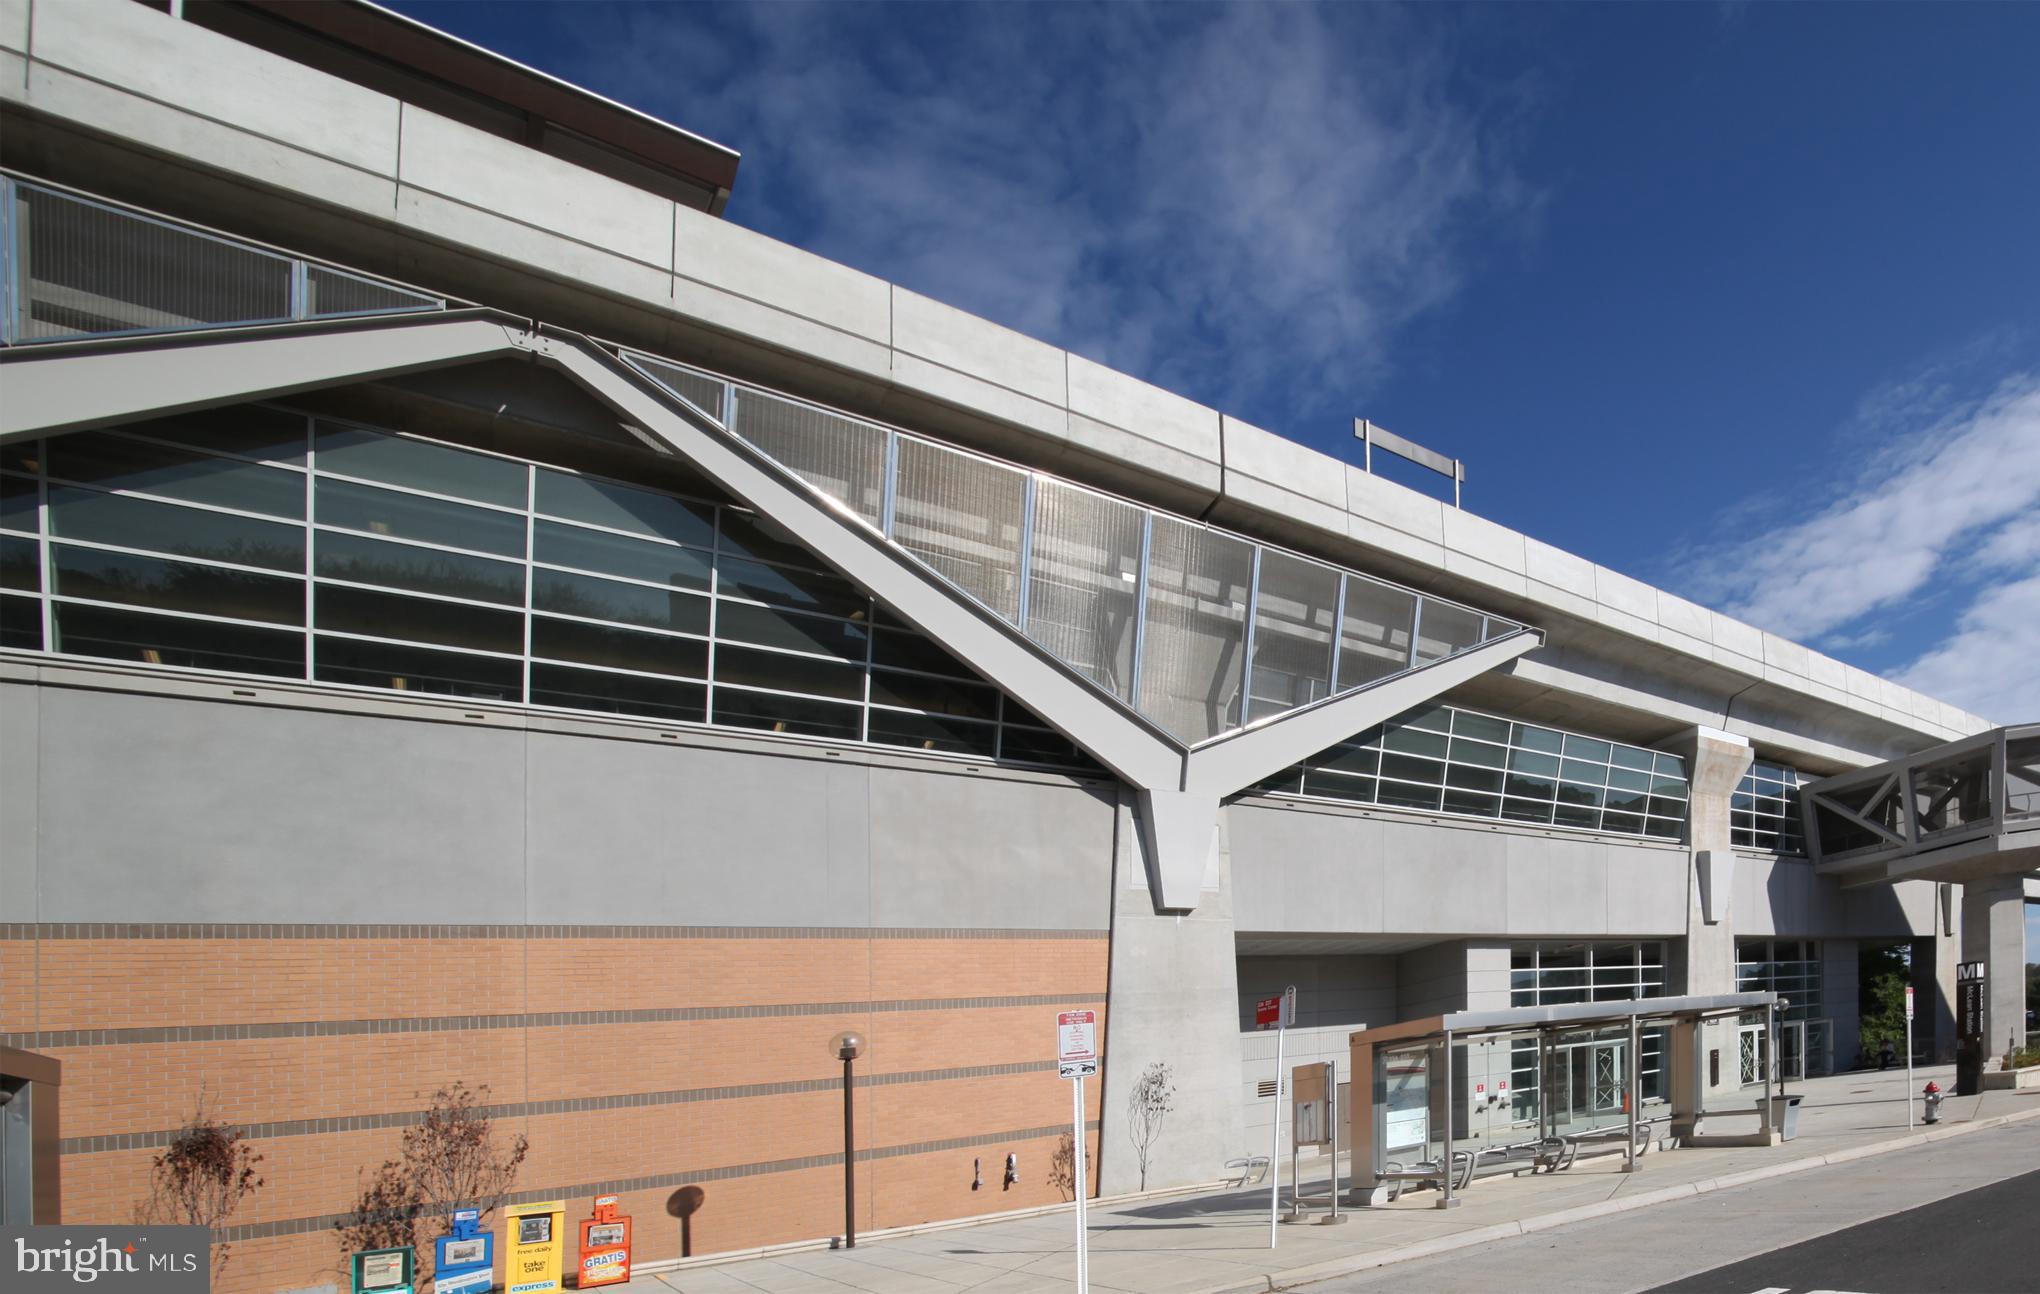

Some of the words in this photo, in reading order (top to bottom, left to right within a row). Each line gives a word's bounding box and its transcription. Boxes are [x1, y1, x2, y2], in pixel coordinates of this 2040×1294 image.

[1958, 964, 1975, 980] M
[517, 1248, 533, 1256] free
[534, 1246, 553, 1255] daily
[523, 1259, 546, 1269] take
[584, 1251, 626, 1268] GRATIS
[524, 1266, 545, 1274] one
[512, 1280, 555, 1293] express
